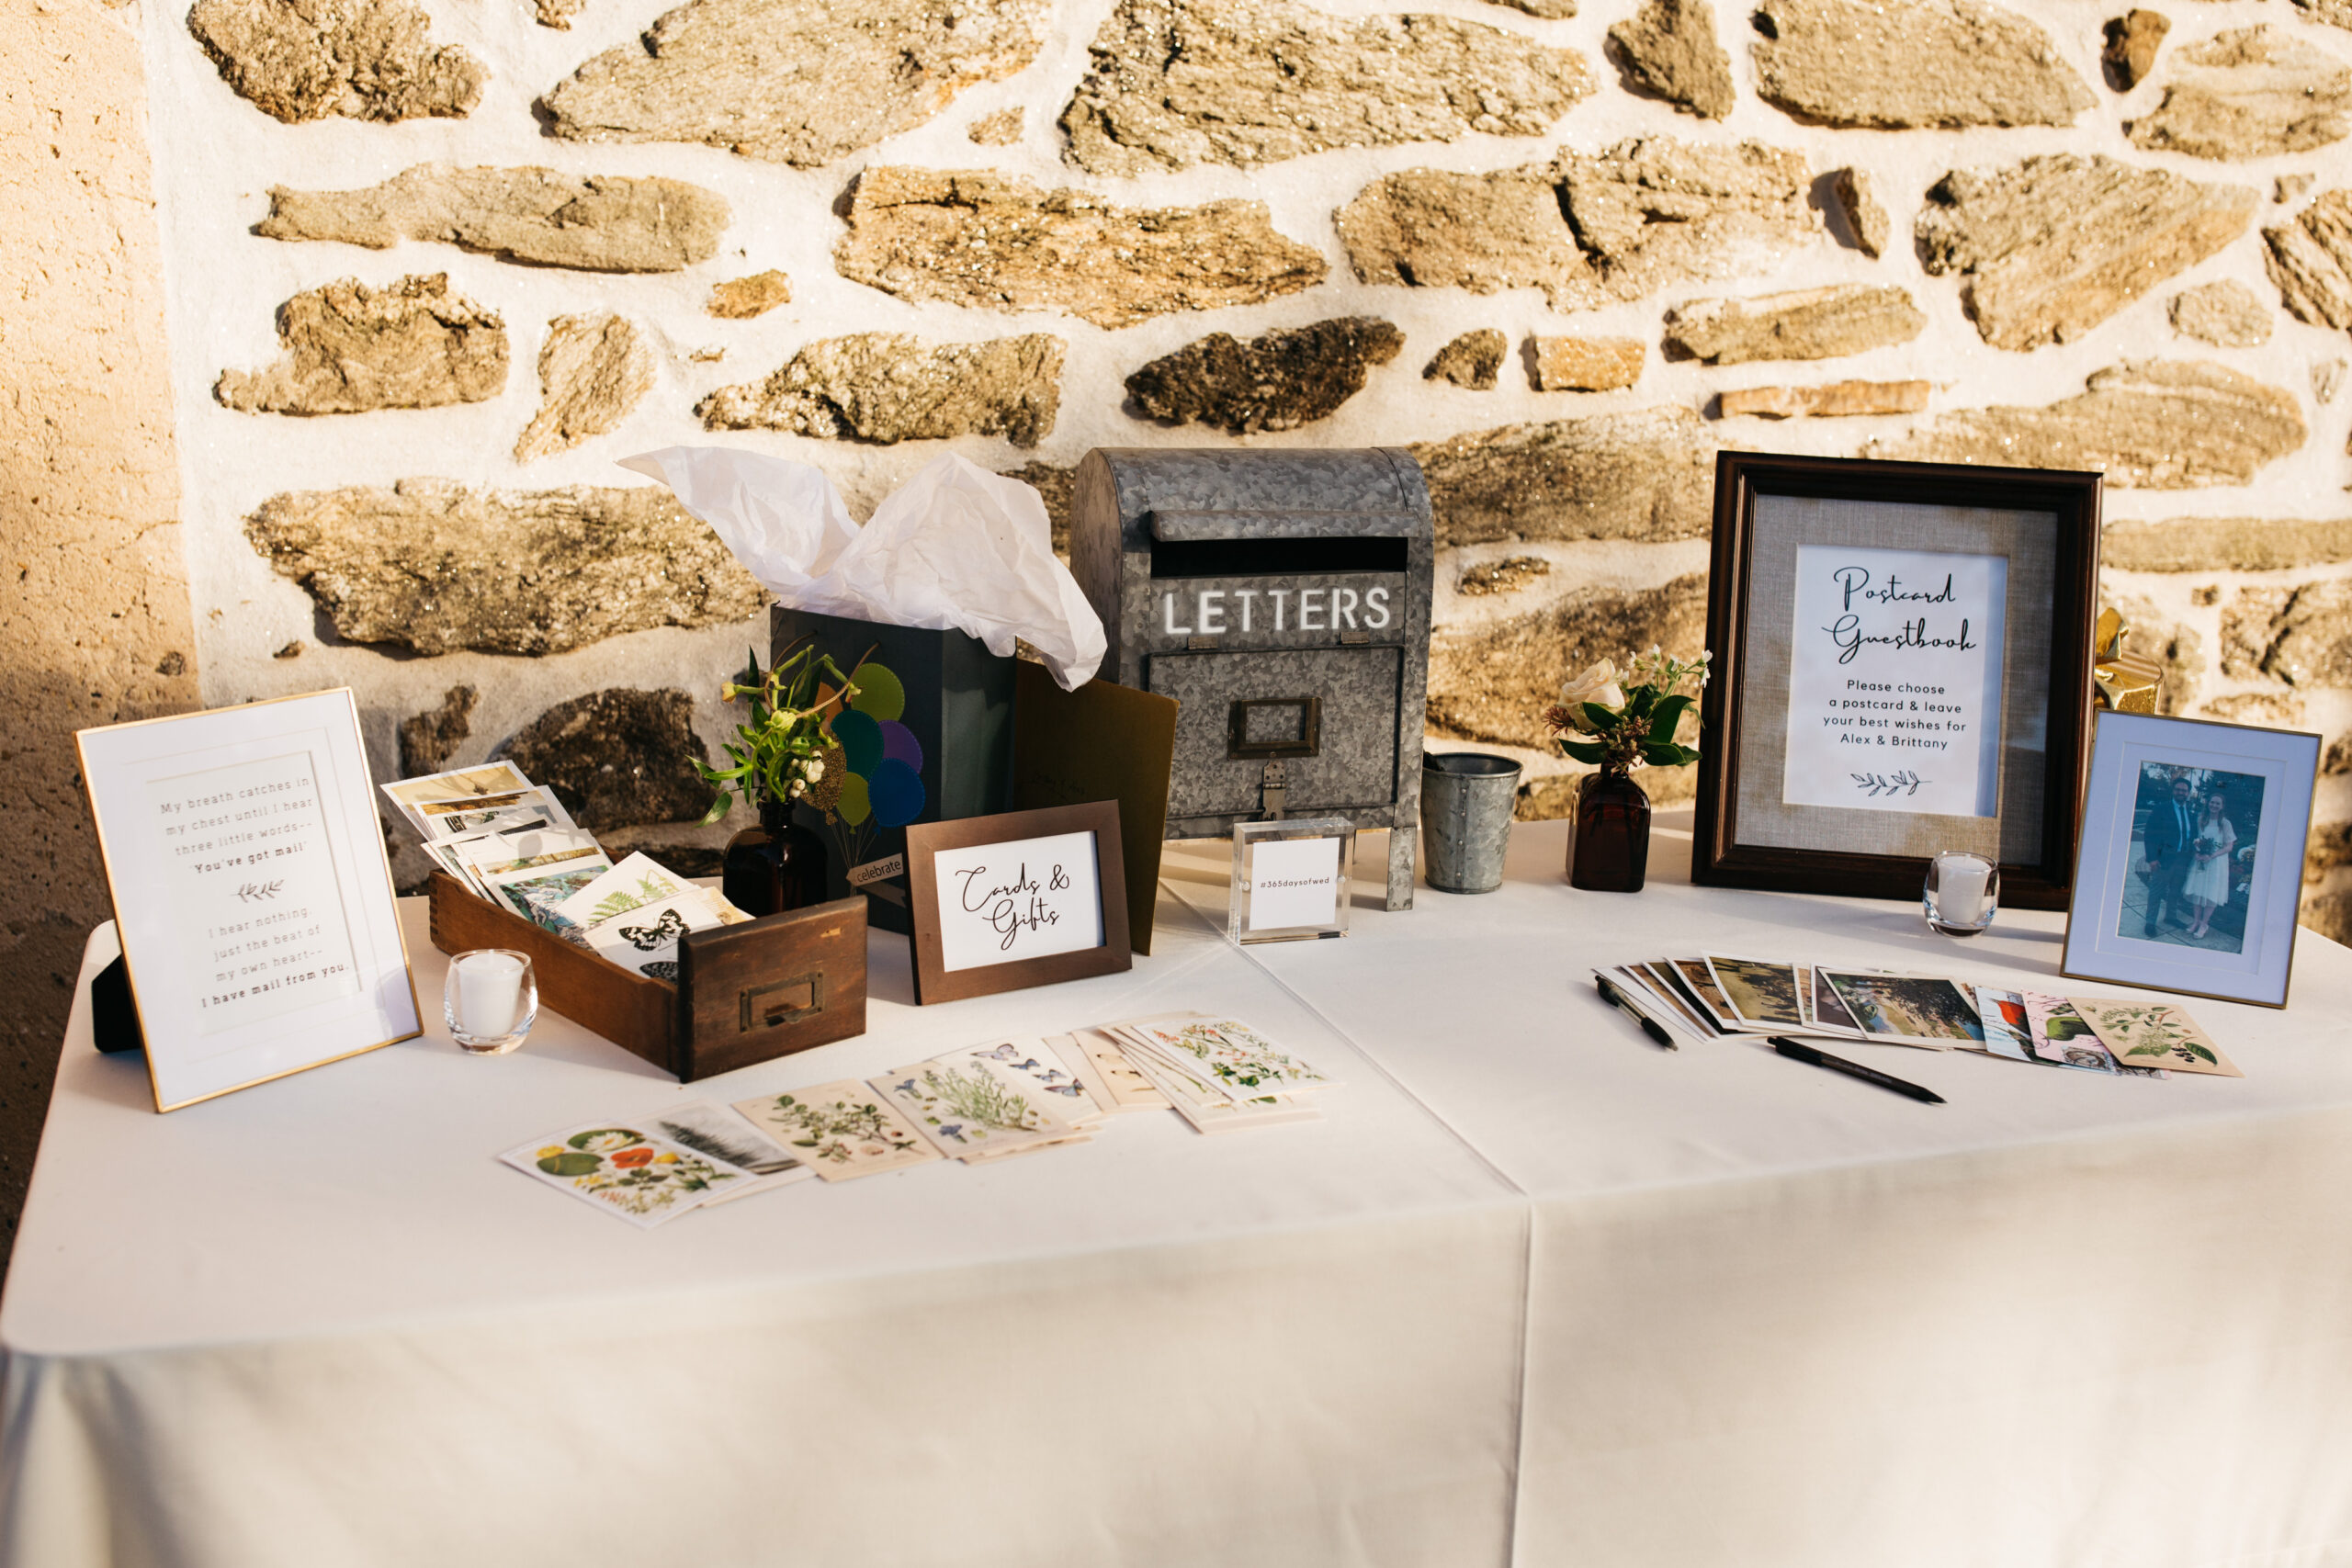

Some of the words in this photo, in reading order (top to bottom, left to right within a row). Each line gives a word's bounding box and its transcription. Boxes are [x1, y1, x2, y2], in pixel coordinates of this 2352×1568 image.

[1833, 566, 1956, 612] Postcard
[1164, 586, 1391, 635] LETTERS
[1821, 614, 1976, 665] Guestbook
[1847, 679, 1892, 692] Please
[1897, 682, 1945, 695] choose
[1828, 698, 1837, 707] a
[1842, 698, 1904, 711] postcard
[1909, 700, 1918, 711] &
[1924, 701, 1962, 714] leave
[1823, 716, 1854, 727] your
[1860, 716, 1889, 728] best
[1894, 718, 1940, 731] wishes
[1947, 720, 1966, 731] for
[1840, 733, 1871, 745] Alex
[1877, 735, 1885, 746] &
[1892, 735, 1948, 751] Brittany
[160, 802, 182, 815] My
[187, 791, 233, 809] breath
[239, 780, 292, 799] catches
[297, 777, 310, 787] in
[165, 824, 186, 836] my
[191, 814, 231, 830] chest
[234, 806, 268, 822] until
[273, 803, 278, 814] I
[283, 798, 313, 812] hear
[175, 840, 214, 856] three
[218, 831, 254, 847] little
[248, 850, 270, 865] got
[856, 861, 902, 883] celebrate
[1260, 876, 1330, 888] #365daysofwed
[955, 862, 1041, 912] Cards
[1049, 863, 1070, 891] &
[208, 928, 214, 939] I
[219, 921, 250, 936] hear
[981, 897, 1059, 951] Gifts
[213, 944, 242, 963] just
[246, 939, 268, 952] the
[273, 930, 303, 944] beat
[307, 924, 321, 937] of
[216, 969, 235, 982] my
[241, 961, 267, 976] own
[201, 998, 207, 1008] I
[212, 989, 246, 1005] have
[251, 978, 280, 995] mail
[286, 970, 317, 986] from
